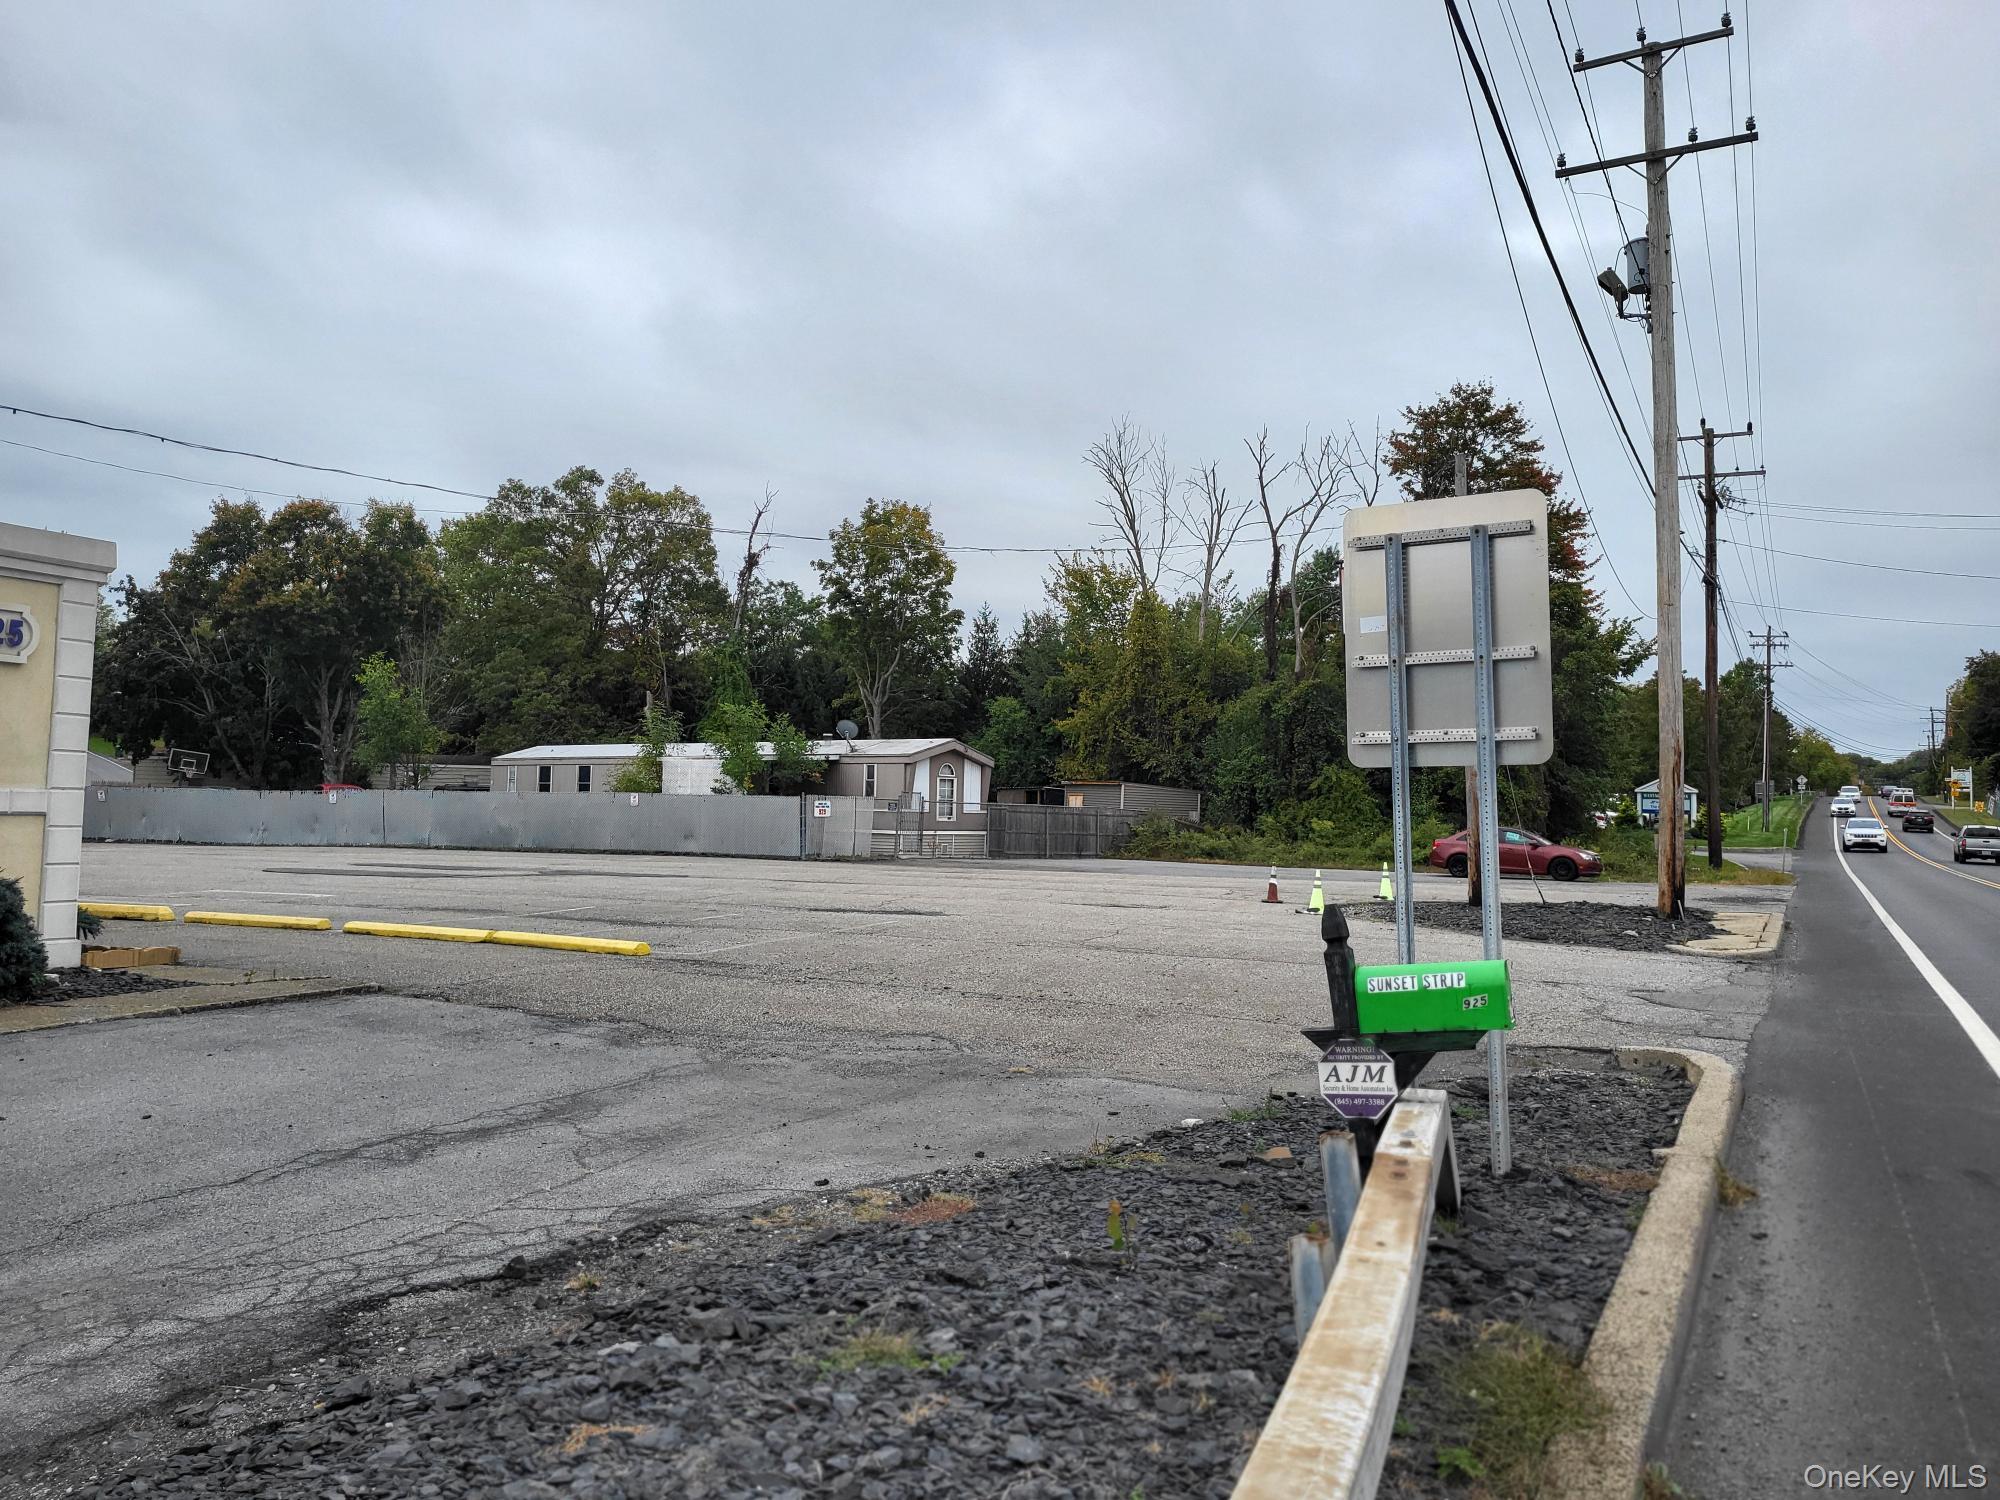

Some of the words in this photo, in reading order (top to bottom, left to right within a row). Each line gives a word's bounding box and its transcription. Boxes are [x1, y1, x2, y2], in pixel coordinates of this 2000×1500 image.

[1368, 976, 1417, 992] SUNSET
[1423, 973, 1464, 989] STRIP
[1463, 996, 1487, 1009] 925
[1324, 1065, 1387, 1083] AJM
